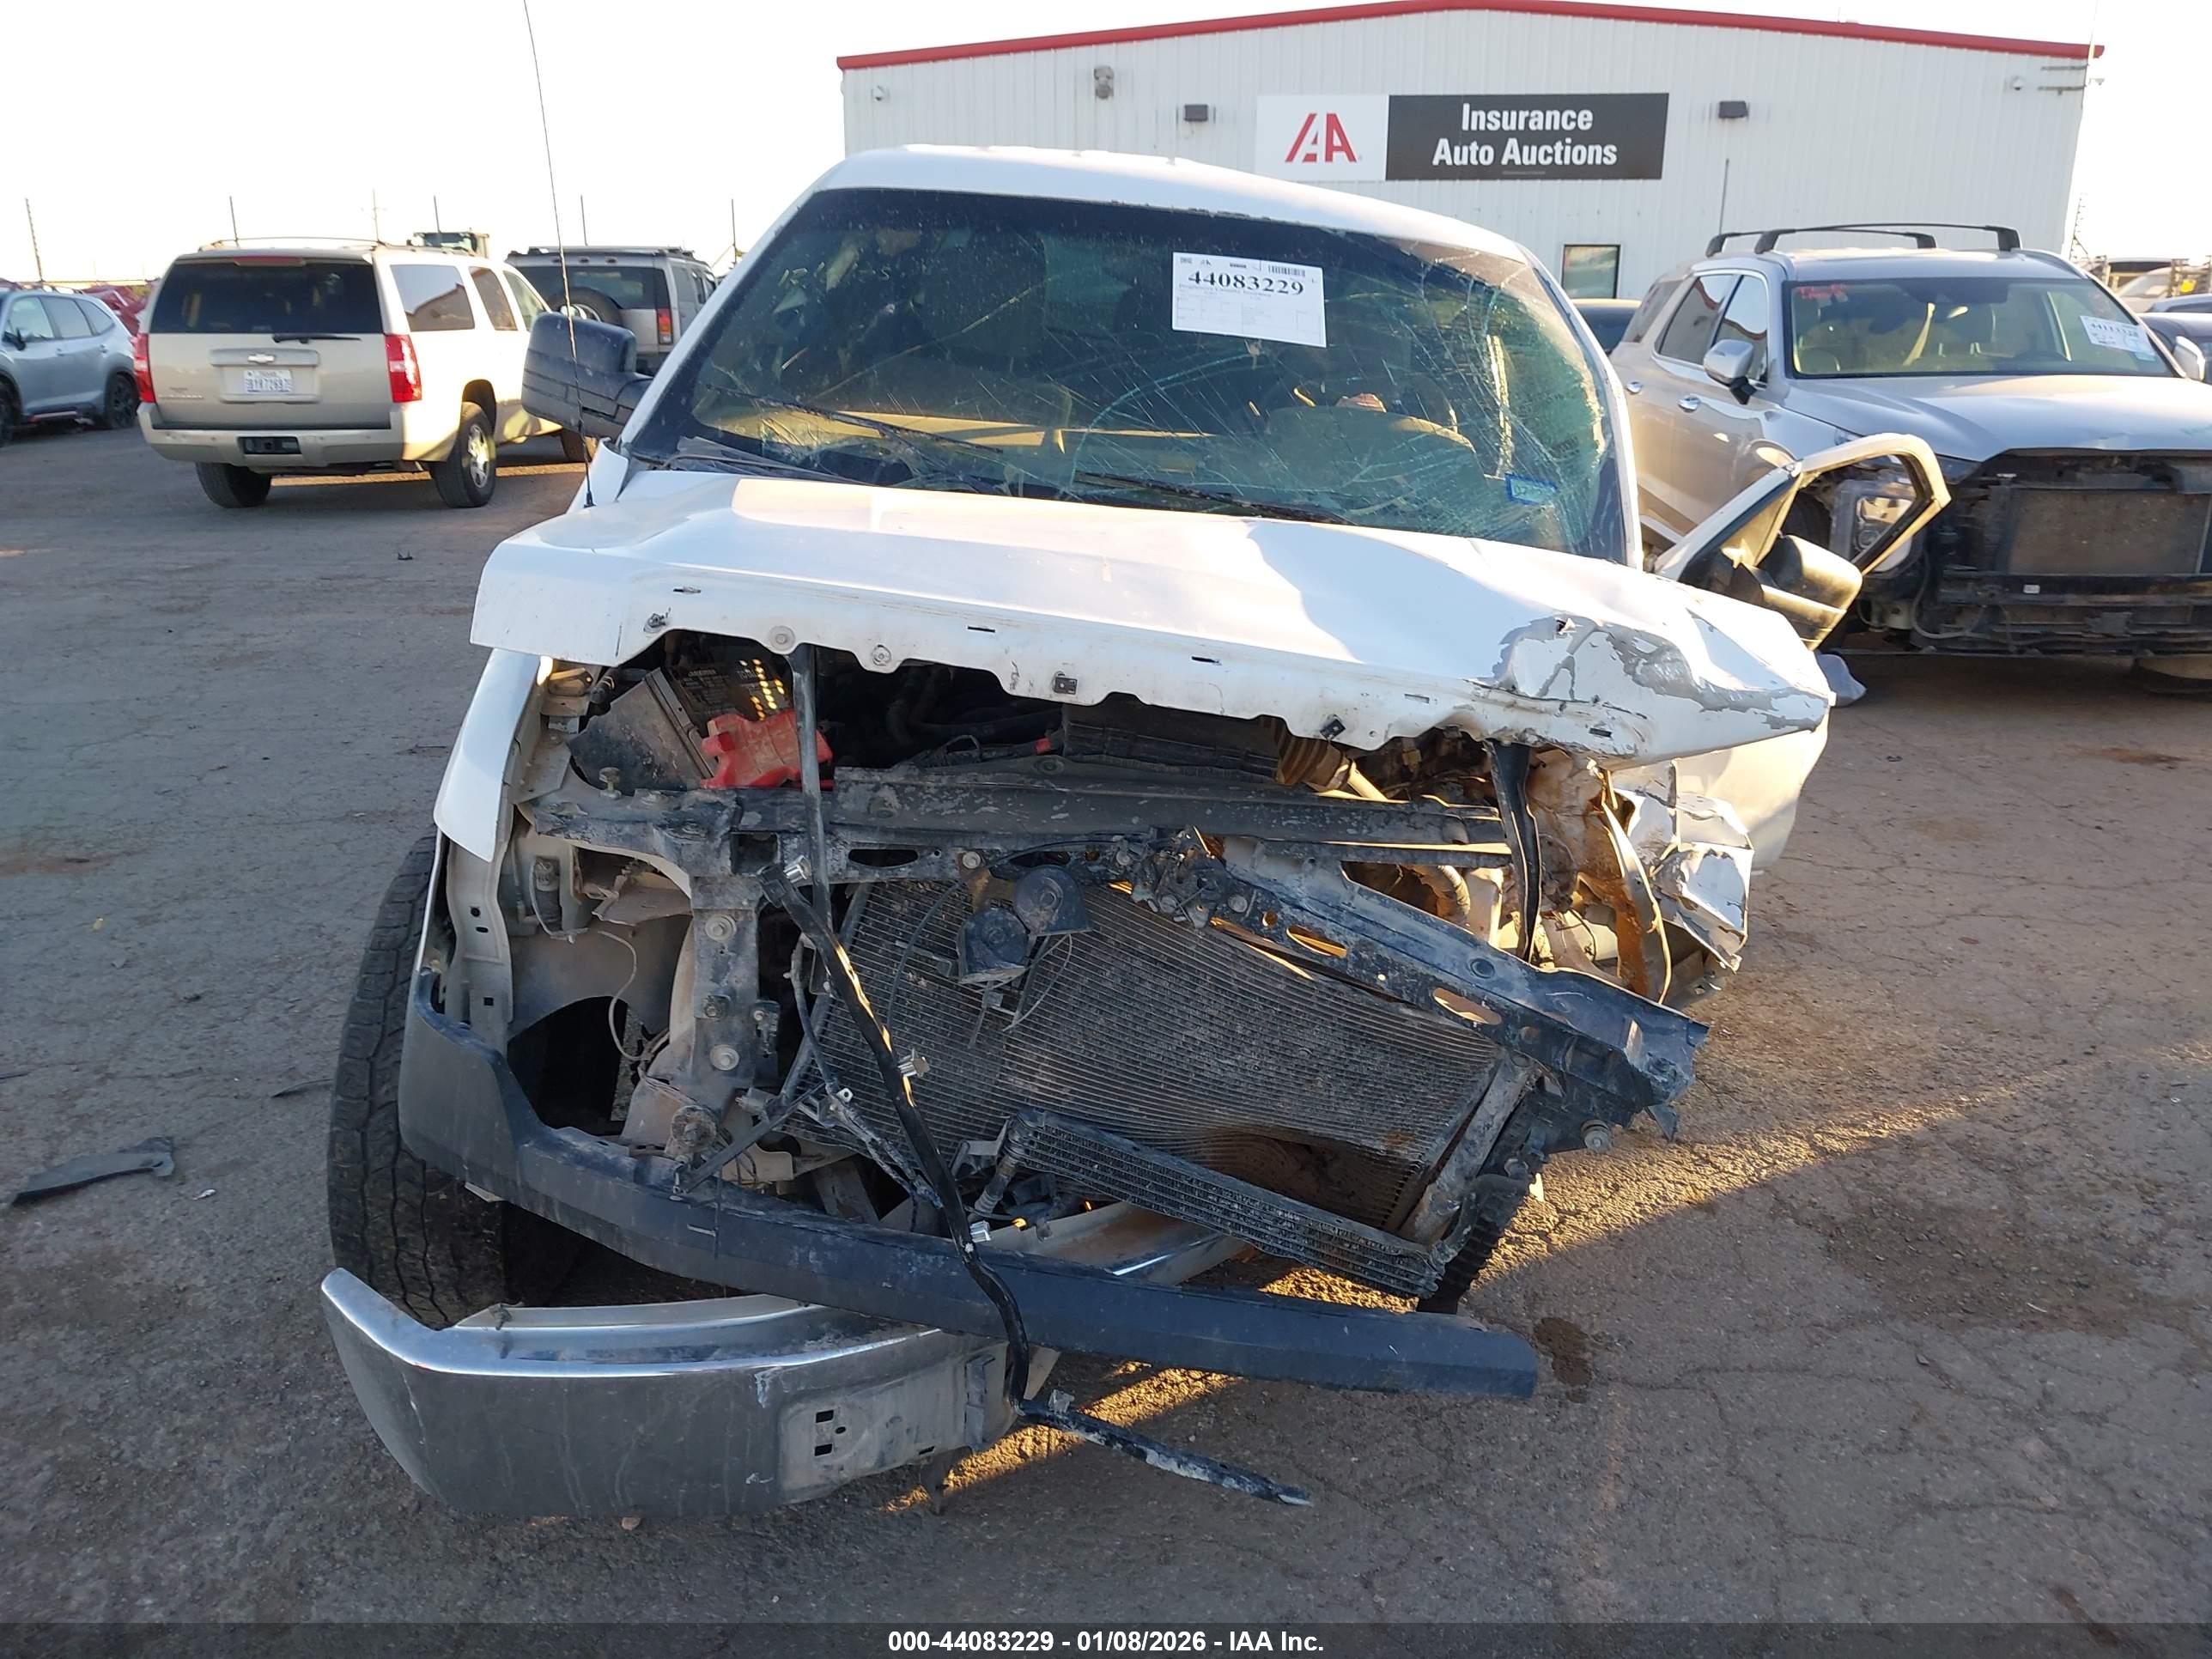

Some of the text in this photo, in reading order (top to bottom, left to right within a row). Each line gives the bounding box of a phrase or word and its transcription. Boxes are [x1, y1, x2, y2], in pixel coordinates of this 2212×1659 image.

[1462, 103, 1594, 131] Insurance
[1431, 137, 1618, 166] Auto Auctions
[1188, 270, 1304, 296] 44083229
